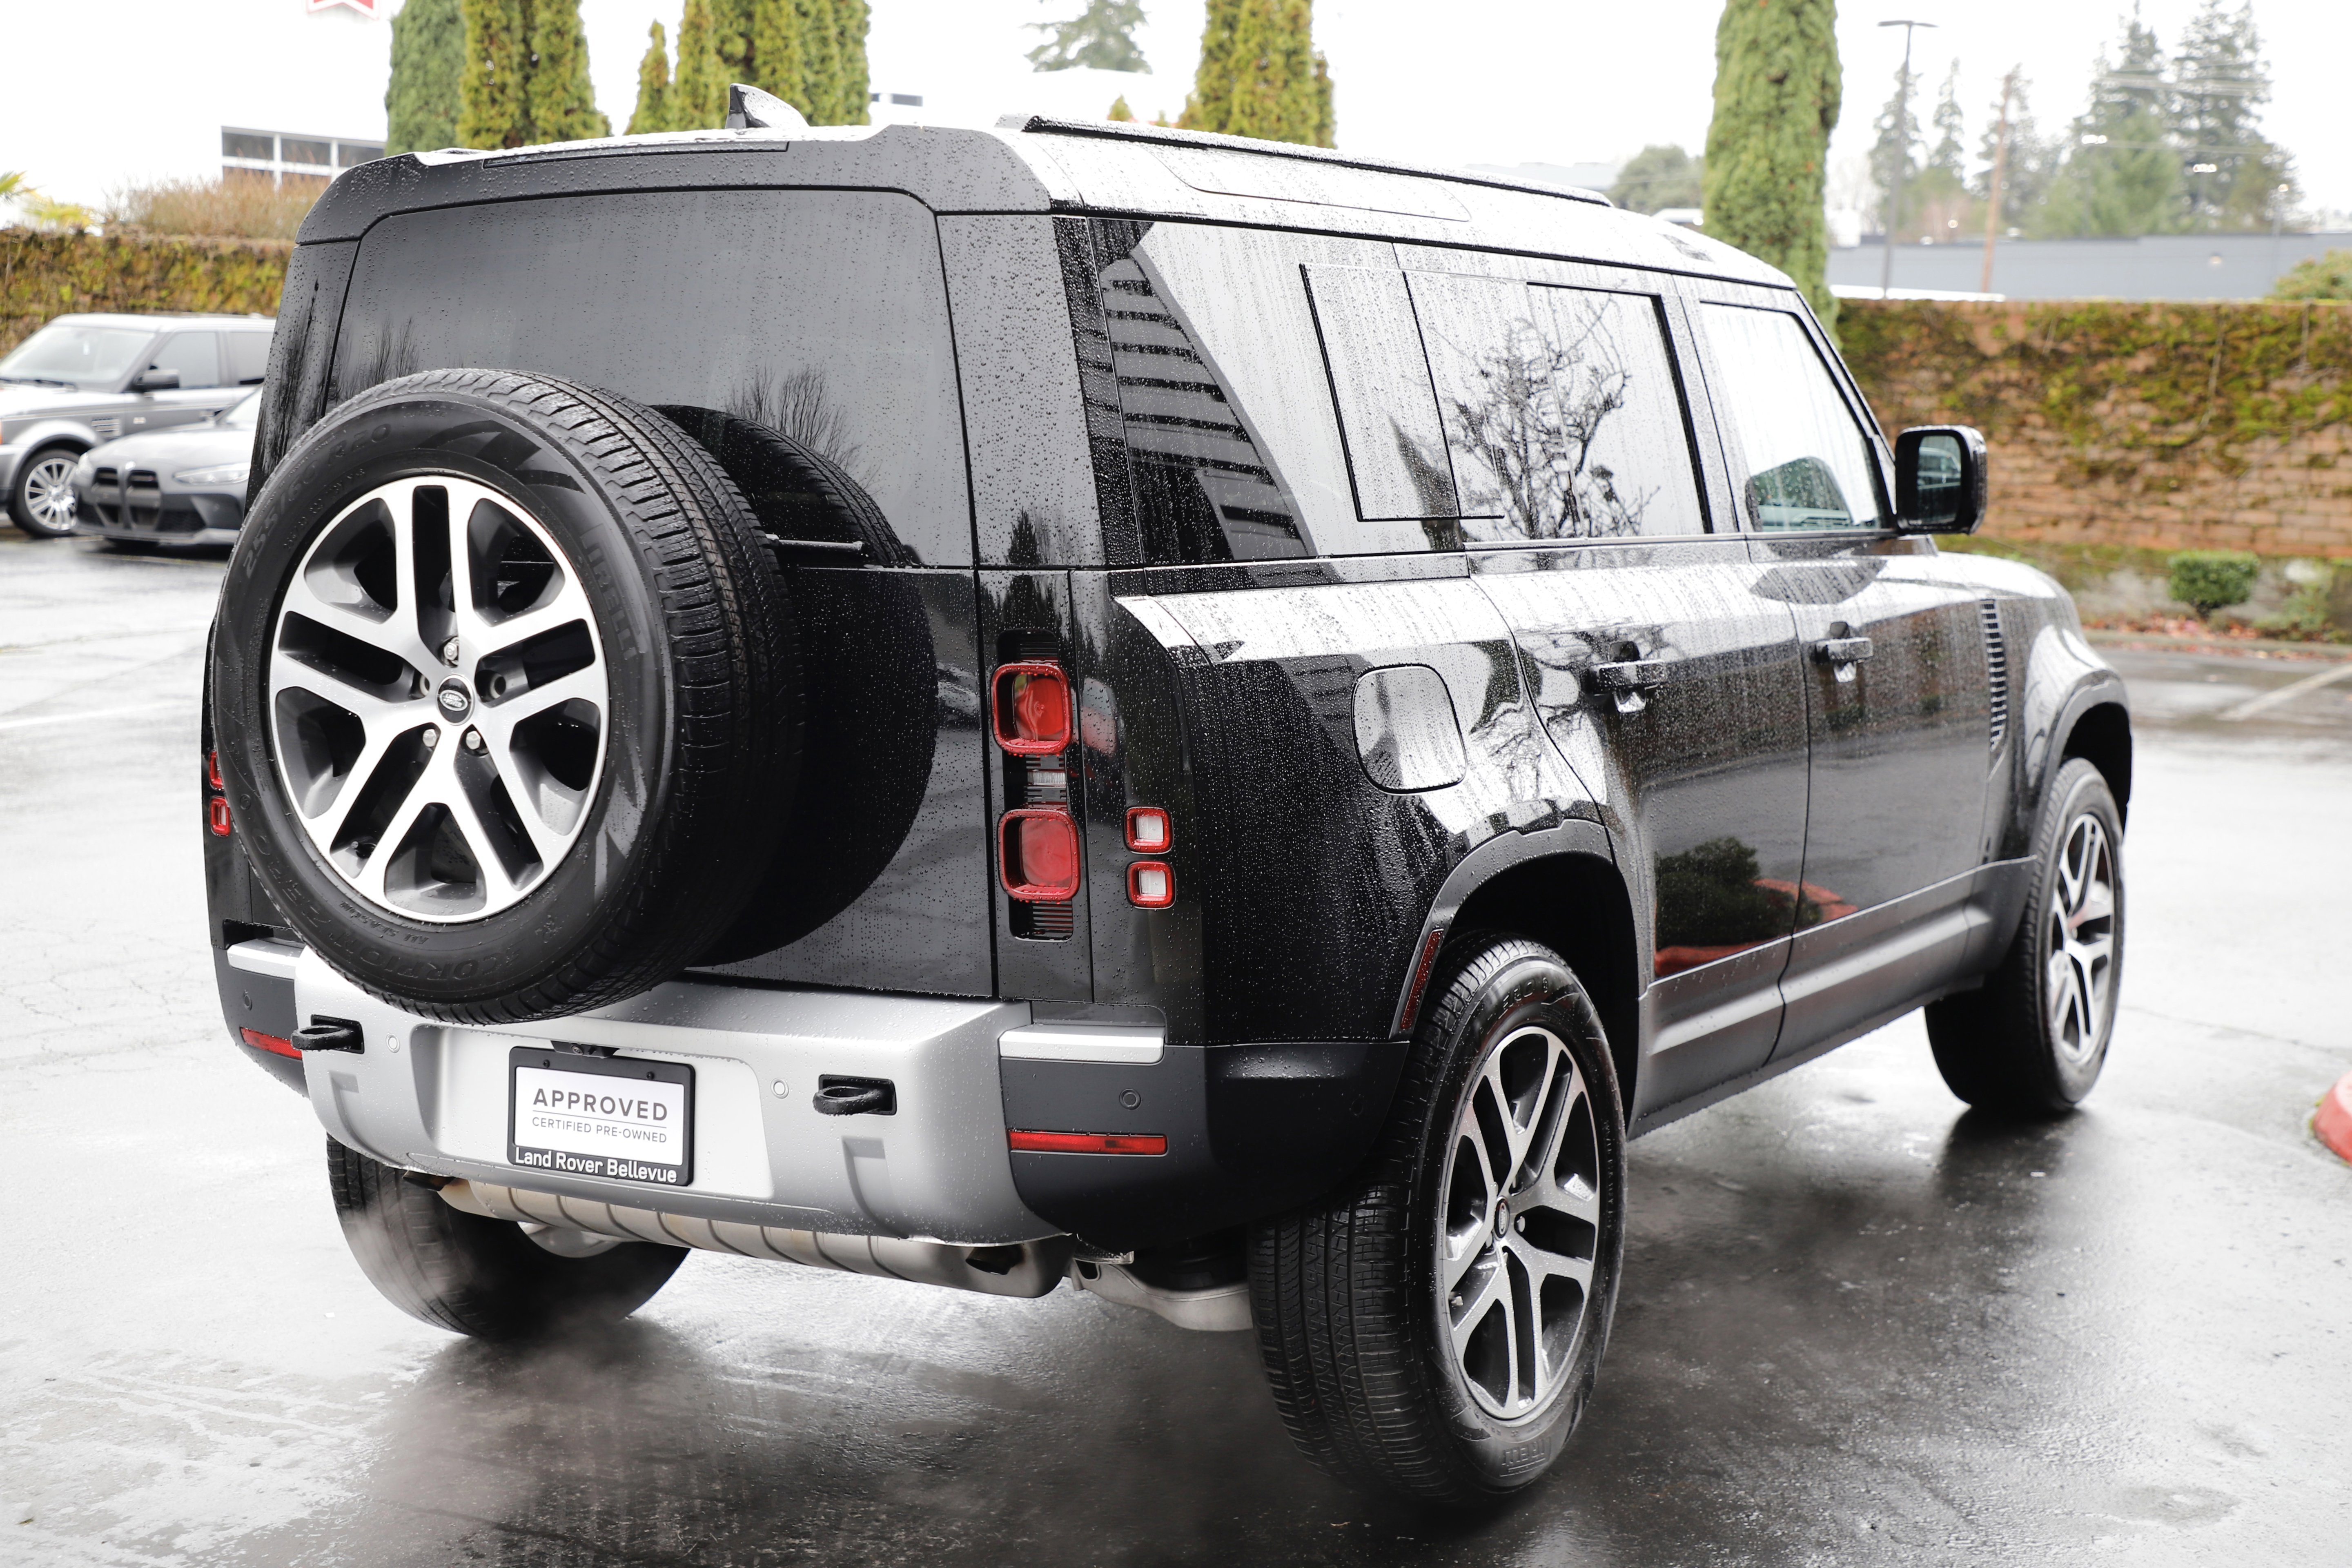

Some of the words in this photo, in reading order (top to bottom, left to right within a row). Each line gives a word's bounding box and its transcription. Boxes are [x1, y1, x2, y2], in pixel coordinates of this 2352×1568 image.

[327, 423, 391, 466] R20
[579, 523, 645, 661] PIRELLI
[445, 693, 459, 701] LAND
[445, 698, 463, 708] ROVER
[533, 1088, 668, 1121] APPROVED
[532, 1117, 592, 1133] CERTIFIED
[596, 1125, 667, 1143] PRE-OWNED
[515, 1147, 552, 1167] Land
[556, 1152, 603, 1174] Rover
[607, 1158, 677, 1183] Bellevue
